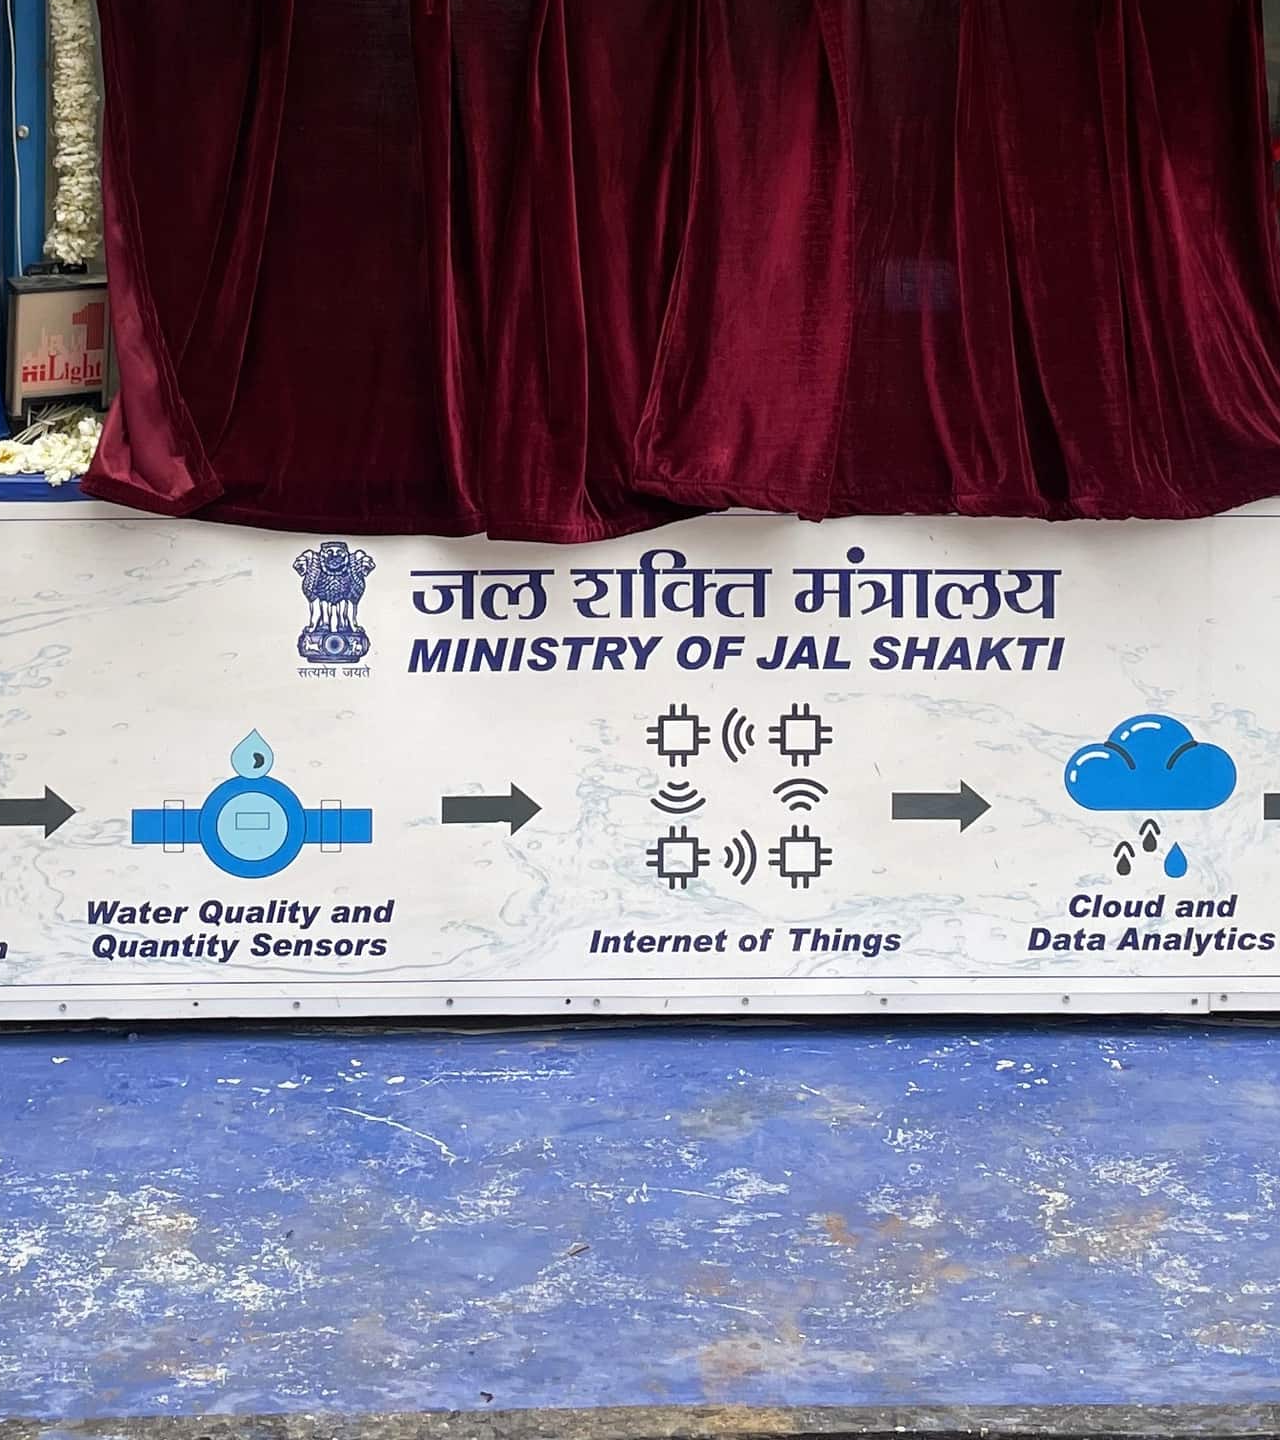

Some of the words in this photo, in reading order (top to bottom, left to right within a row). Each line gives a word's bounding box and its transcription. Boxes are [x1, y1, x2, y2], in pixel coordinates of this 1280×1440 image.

[72, 302, 105, 350] 1
[411, 569, 554, 620] जल
[573, 549, 772, 620] शक्ति
[793, 547, 1062, 619] मंत्रालय
[408, 636, 663, 672] MINISTRY
[677, 636, 745, 670] OF
[757, 636, 851, 669] JAL
[870, 636, 1065, 670] SHAKTI
[297, 664, 337, 678] सत्यमेव
[342, 664, 371, 678] जयते
[88, 901, 189, 924] Water
[199, 900, 321, 929] Quality
[331, 900, 394, 923] and
[1069, 895, 1165, 917] Cloud
[1175, 895, 1237, 917] and
[93, 934, 240, 963] Quantity
[251, 933, 387, 956] Sensors
[590, 930, 728, 953] Internet
[742, 929, 776, 953] of
[789, 928, 901, 957] Things
[1028, 928, 1105, 950] Data
[1117, 927, 1275, 956] Analytics
